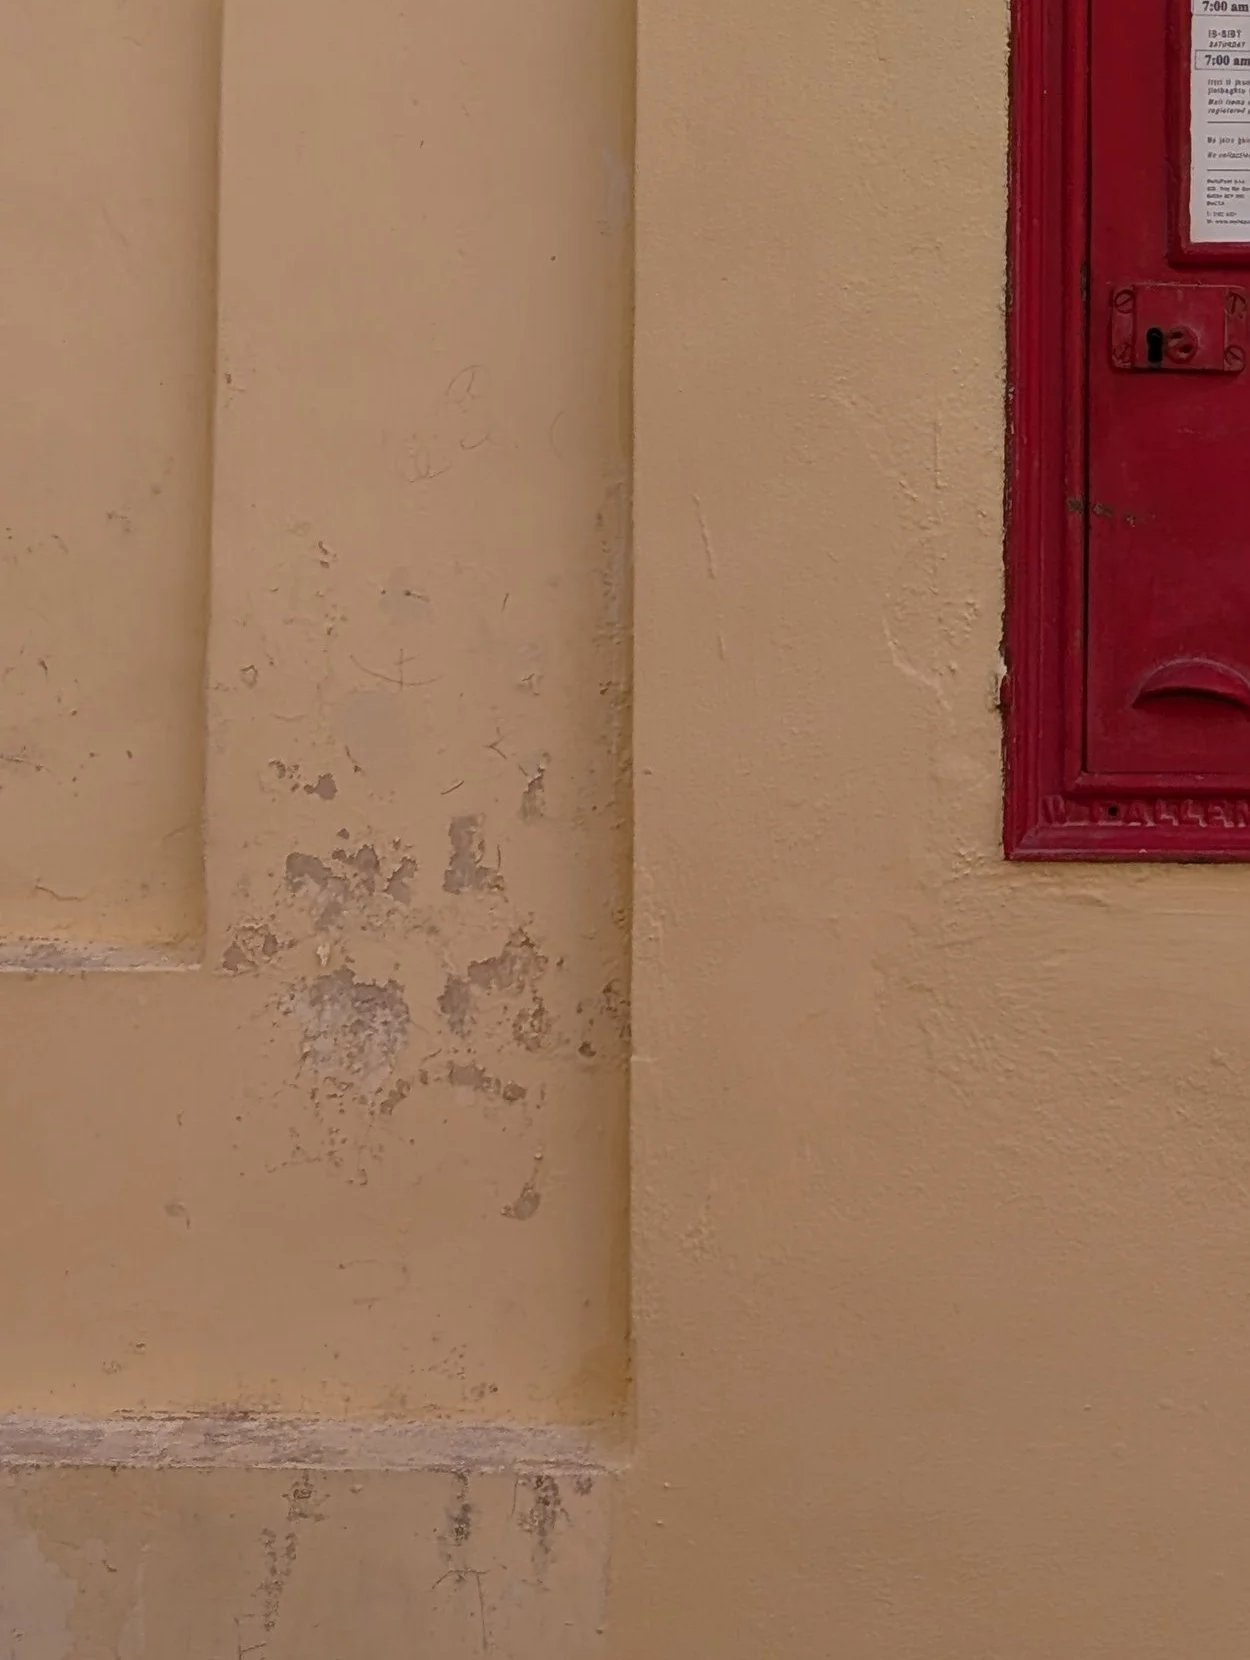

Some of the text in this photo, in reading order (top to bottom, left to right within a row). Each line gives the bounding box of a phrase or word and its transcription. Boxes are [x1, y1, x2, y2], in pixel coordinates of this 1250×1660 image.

[1201, 0, 1250, 13] 7:00 am
[1204, 54, 1231, 67] 7:00
